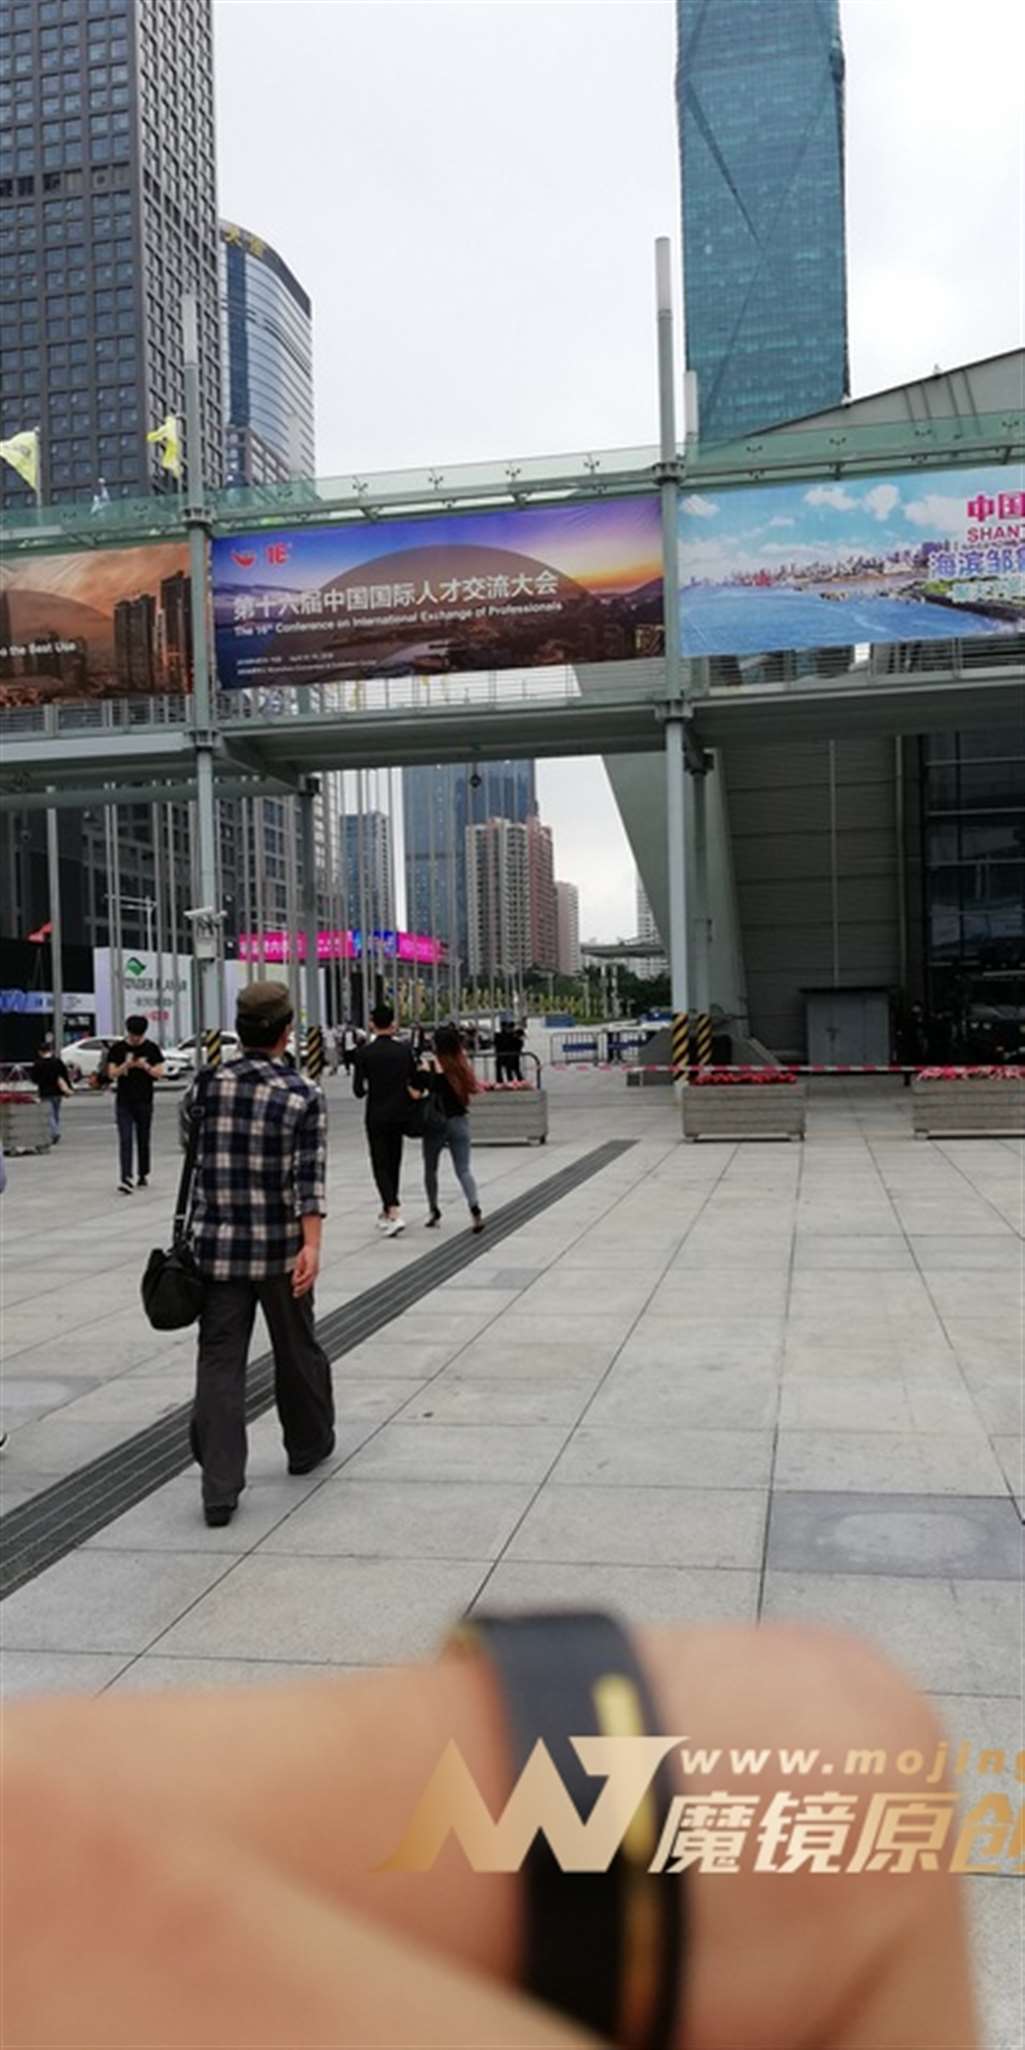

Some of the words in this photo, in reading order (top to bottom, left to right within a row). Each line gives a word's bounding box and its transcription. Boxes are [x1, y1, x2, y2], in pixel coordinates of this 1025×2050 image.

[967, 493, 1025, 522] 中国
[234, 570, 559, 620] 第十六届中国国际人才交流大会
[276, 620, 334, 633] Conference
[337, 619, 350, 628] on
[353, 611, 417, 627] International
[420, 608, 472, 622] Exchange
[475, 606, 487, 618] of
[488, 601, 562, 616] Professionals
[28, 642, 53, 654] Best
[55, 641, 76, 653] Use
